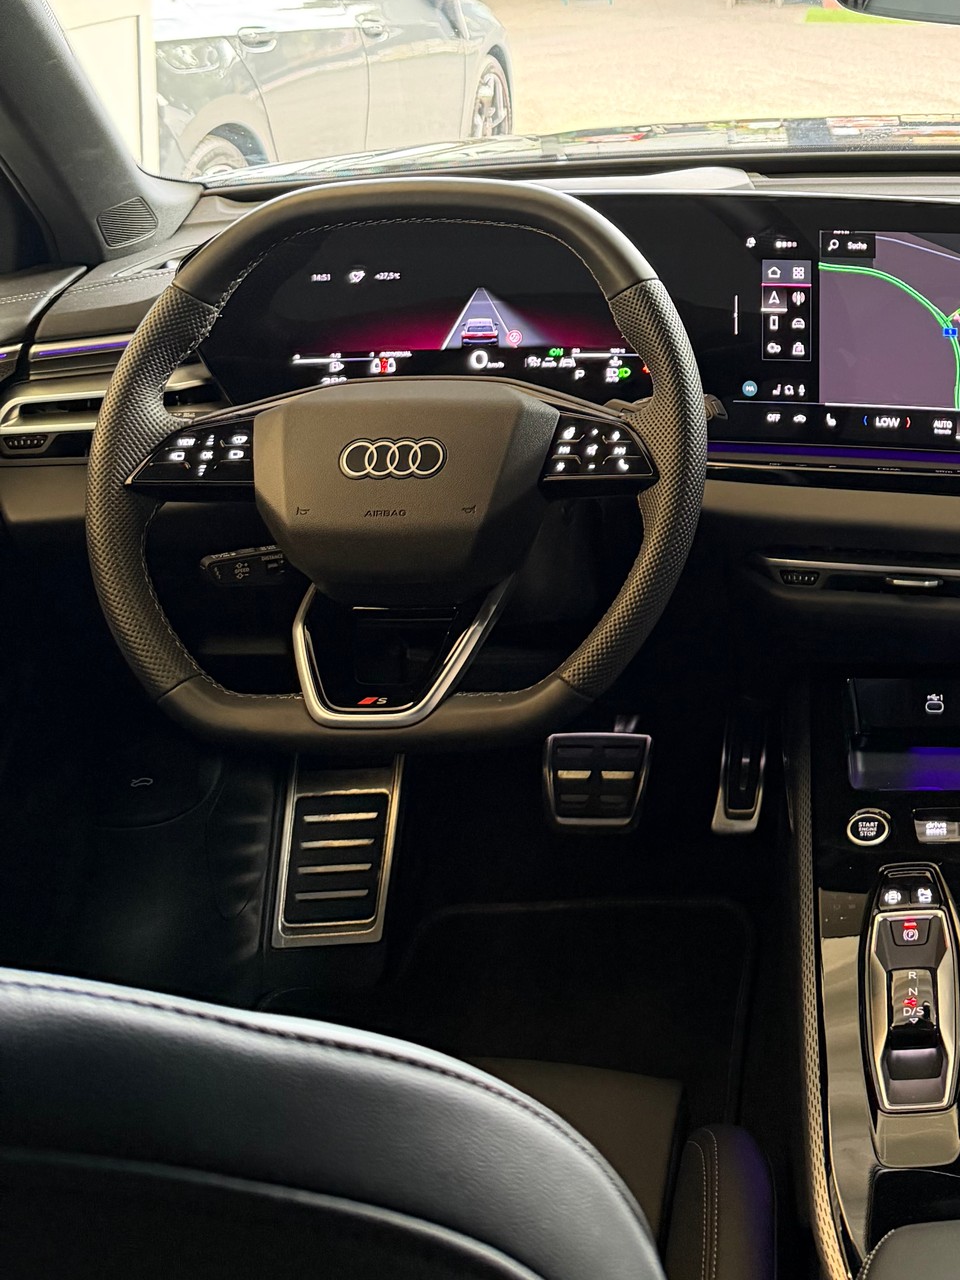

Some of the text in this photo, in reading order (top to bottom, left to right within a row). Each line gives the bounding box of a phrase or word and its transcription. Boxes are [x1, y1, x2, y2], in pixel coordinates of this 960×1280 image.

[847, 241, 868, 250] Suche
[549, 348, 564, 356] ON
[470, 350, 488, 369] 0
[575, 370, 585, 380] P
[766, 413, 782, 422] OFF
[875, 416, 901, 428] LOW
[933, 420, 953, 429] AUTO
[177, 438, 196, 447] VIEW
[200, 451, 214, 460] OK
[364, 509, 407, 518] AIRBAG
[926, 821, 947, 829] drive
[908, 972, 917, 980] R
[908, 987, 918, 996] N
[903, 1006, 925, 1017] D/S
